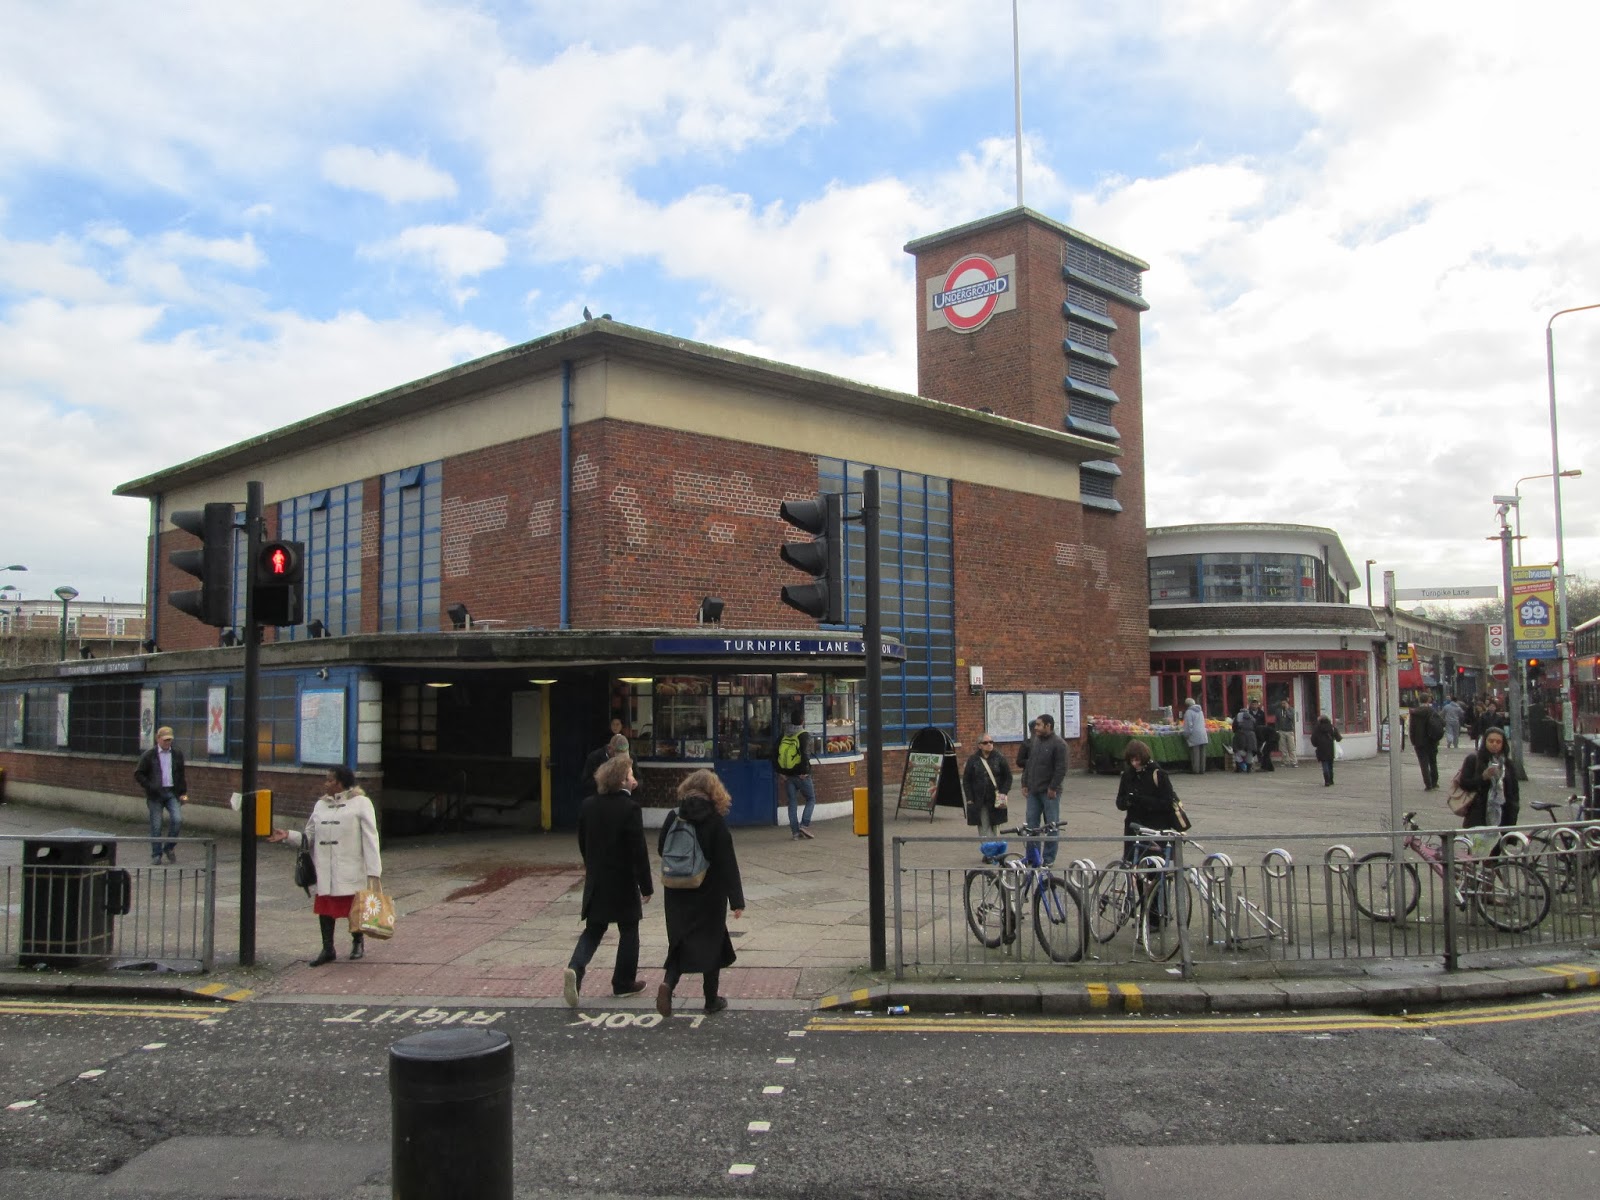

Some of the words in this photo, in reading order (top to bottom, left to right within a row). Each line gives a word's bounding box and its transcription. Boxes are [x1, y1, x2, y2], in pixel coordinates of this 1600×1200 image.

[934, 277, 1007, 309] UNDERGROUND
[1421, 589, 1451, 598] Turnpike
[724, 639, 802, 652] TURNPIKE
[818, 641, 849, 652] LANE
[322, 1008, 506, 1025] RIGHT
[564, 1012, 707, 1028] LOOK
